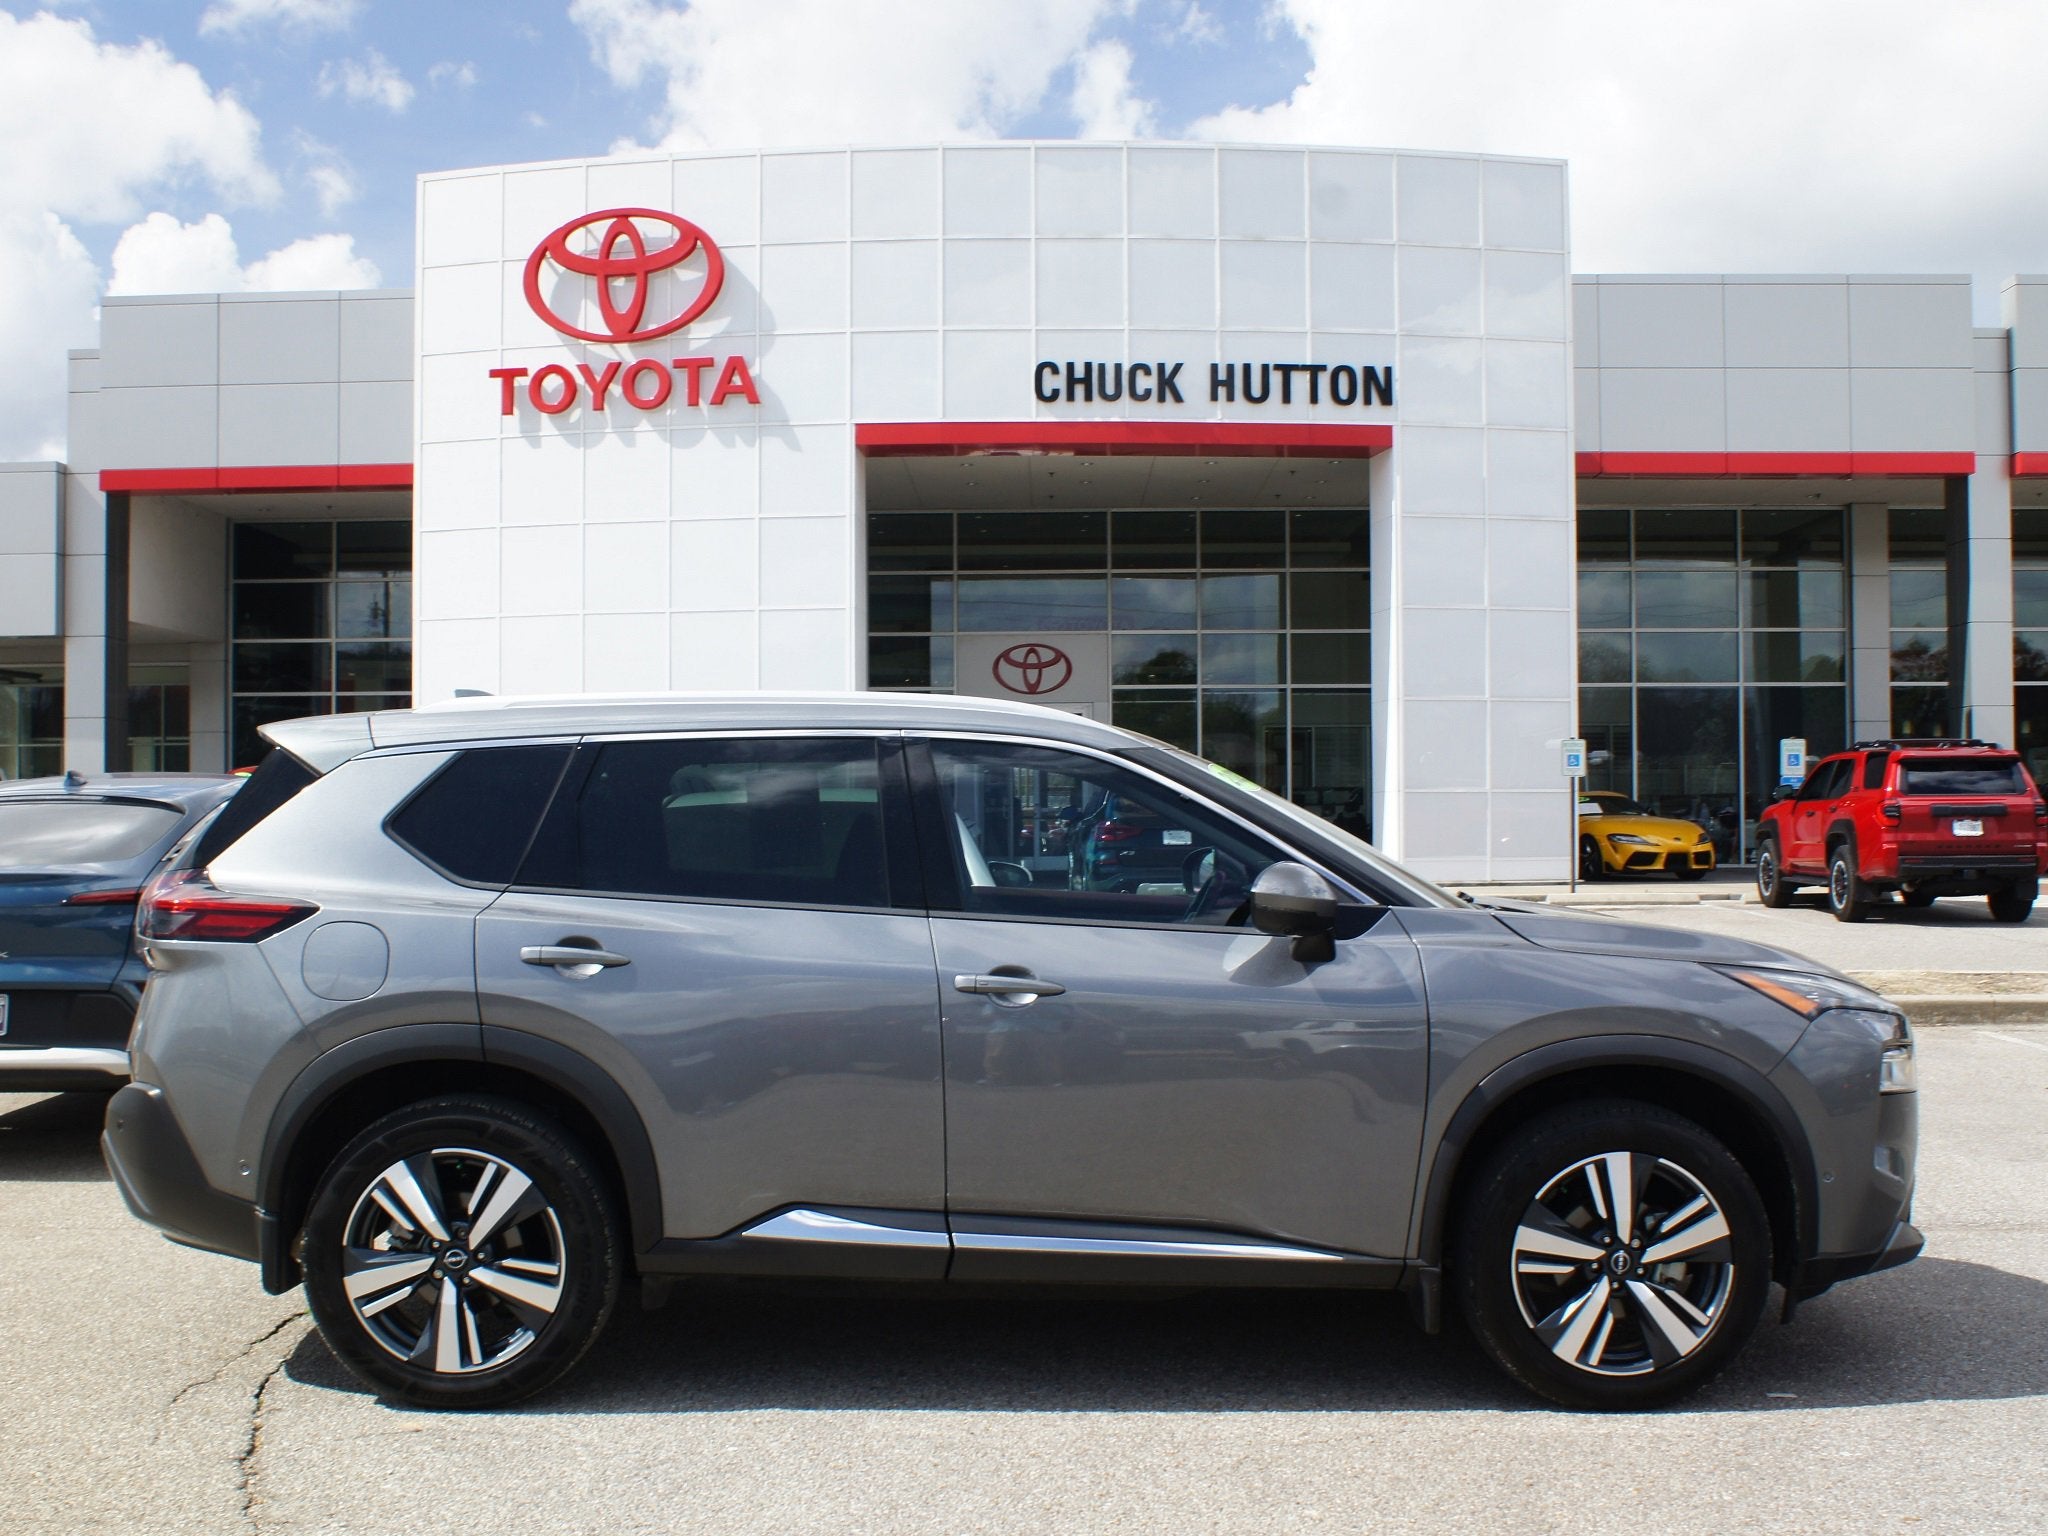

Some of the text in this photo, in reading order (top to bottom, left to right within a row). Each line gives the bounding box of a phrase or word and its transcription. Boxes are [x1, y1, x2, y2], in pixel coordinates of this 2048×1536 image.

[489, 355, 761, 416] TOYOTA
[1034, 361, 1394, 407] CHUCK HUTTON
